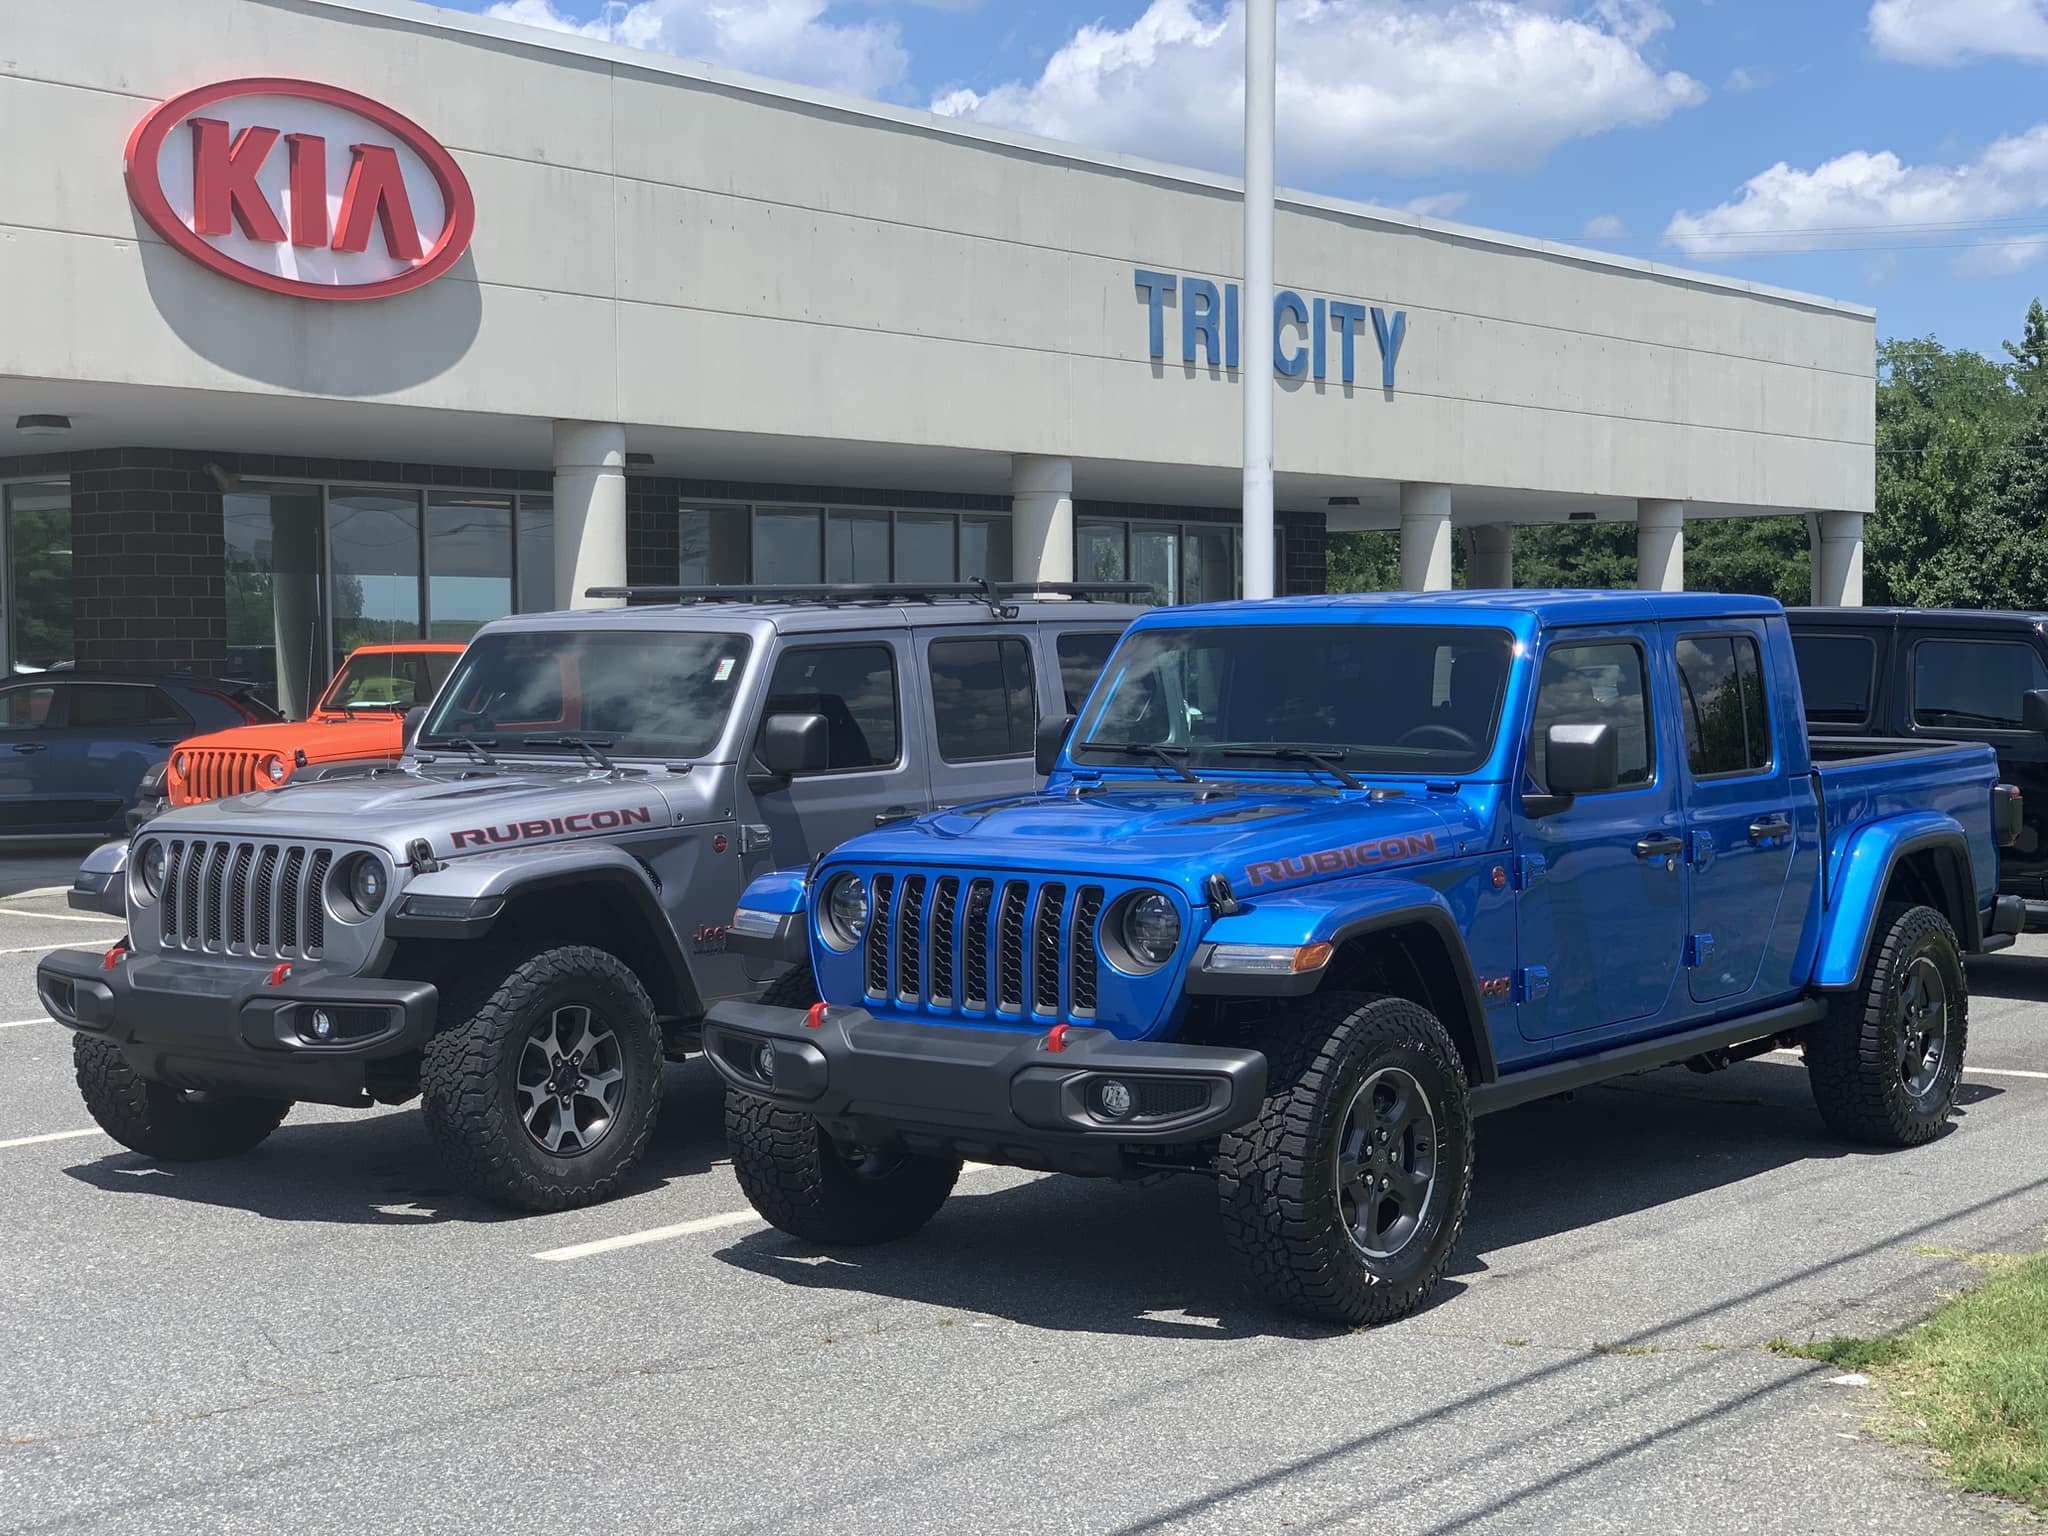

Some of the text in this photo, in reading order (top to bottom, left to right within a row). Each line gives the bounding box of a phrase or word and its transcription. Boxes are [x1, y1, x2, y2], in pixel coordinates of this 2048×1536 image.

[187, 117, 424, 260] KIA
[1134, 268, 1407, 386] TRI CITY
[450, 806, 651, 849] RUBICON
[1246, 833, 1436, 886] RUBICON
